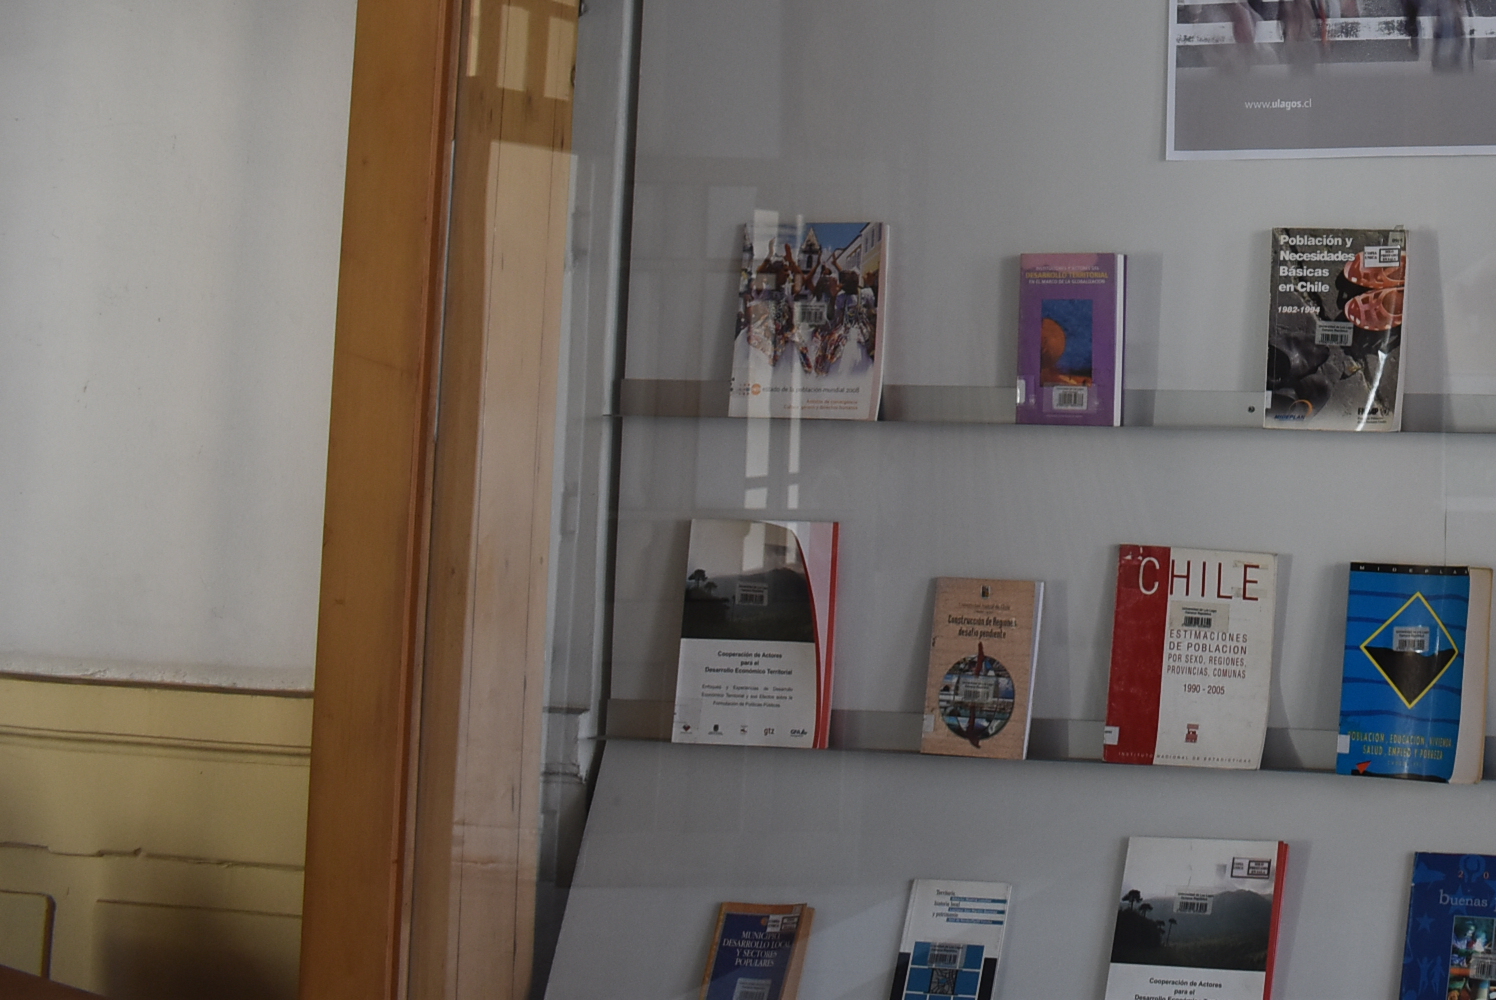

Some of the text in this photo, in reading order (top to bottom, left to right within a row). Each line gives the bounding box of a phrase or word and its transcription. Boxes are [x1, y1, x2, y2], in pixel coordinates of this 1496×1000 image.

[1244, 98, 1312, 110] www.ulagos.cl
[1279, 234, 1353, 247] Población y
[1279, 250, 1356, 261] Necesidades
[1279, 265, 1330, 277] Básicas
[1279, 281, 1330, 293] en Chile
[1138, 556, 1260, 601] CHILE
[986, 616, 992, 626] de
[1169, 629, 1248, 643] ESTIMACIONES
[1169, 641, 1247, 655] DE POBLACION
[718, 651, 753, 659] Cooperación
[1168, 653, 1182, 663] POR
[1212, 668, 1246, 679] COMUNAS
[1184, 683, 1201, 694] 1990
[1207, 685, 1225, 695] 2005
[764, 728, 775, 736] gtz
[1438, 889, 1489, 908] buenas
[722, 938, 792, 949] DESARROLLO LOCAL
[736, 948, 778, 958] Y SECTORES
[734, 958, 775, 967] POPULARES
[1149, 977, 1188, 987] Cooperación
[1198, 980, 1222, 988] Actores
